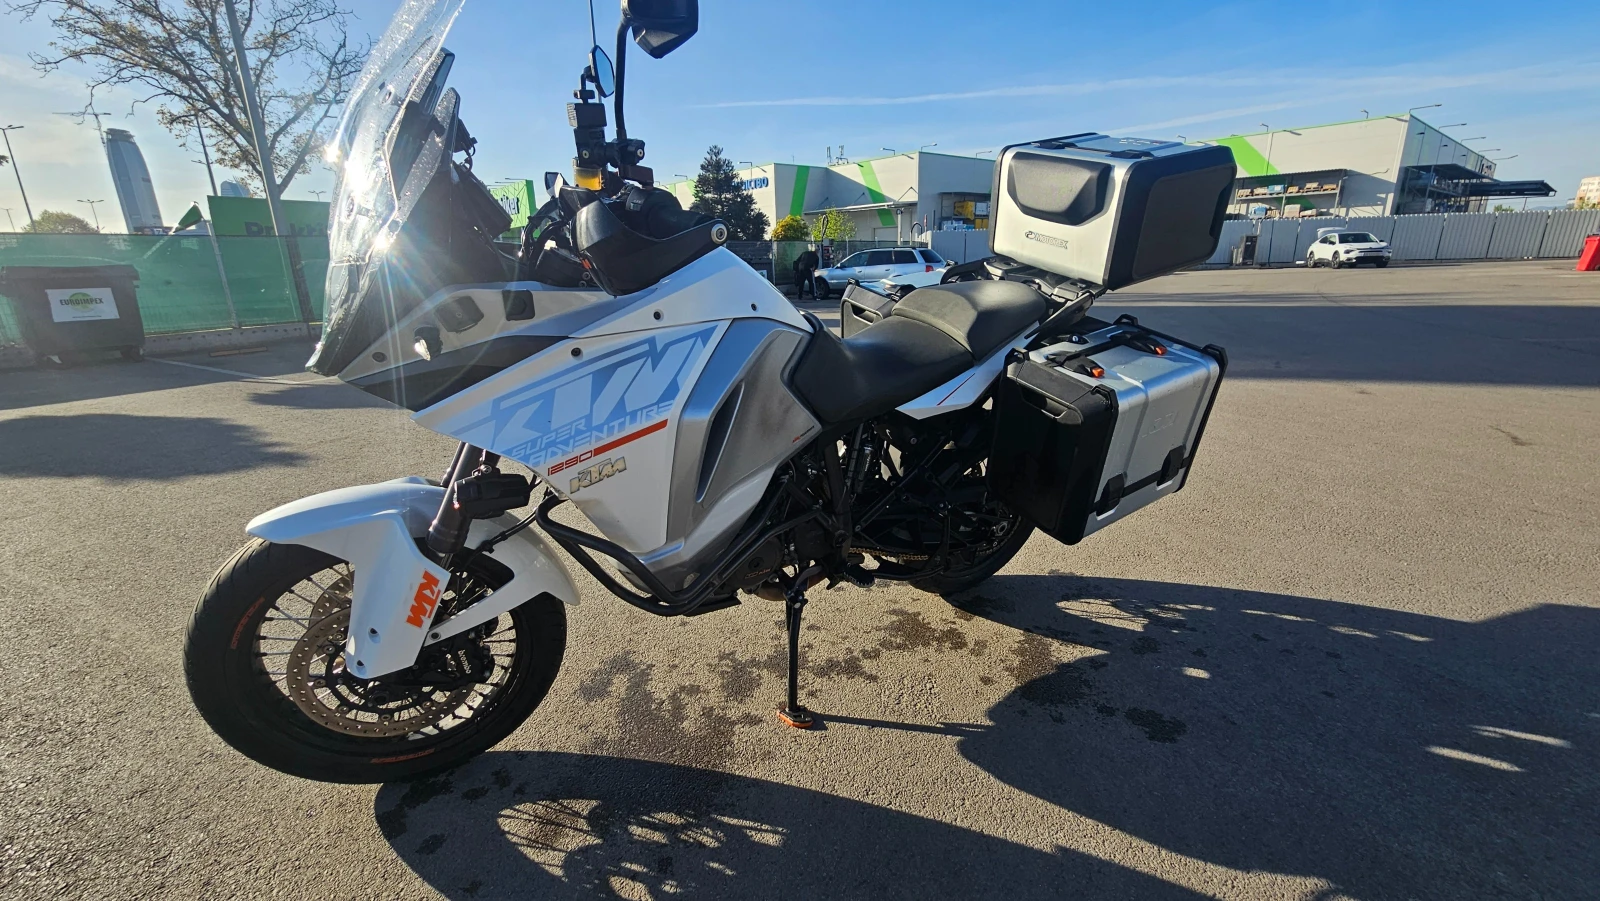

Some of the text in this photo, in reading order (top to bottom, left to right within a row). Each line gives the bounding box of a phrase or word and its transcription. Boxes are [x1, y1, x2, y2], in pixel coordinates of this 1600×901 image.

[60, 297, 104, 306] EUROIMPEX
[511, 419, 588, 458] SUPER
[529, 400, 675, 468] ADVENTURE
[547, 449, 593, 476] 1290
[569, 456, 627, 494] KTM
[406, 570, 441, 628] KTM
